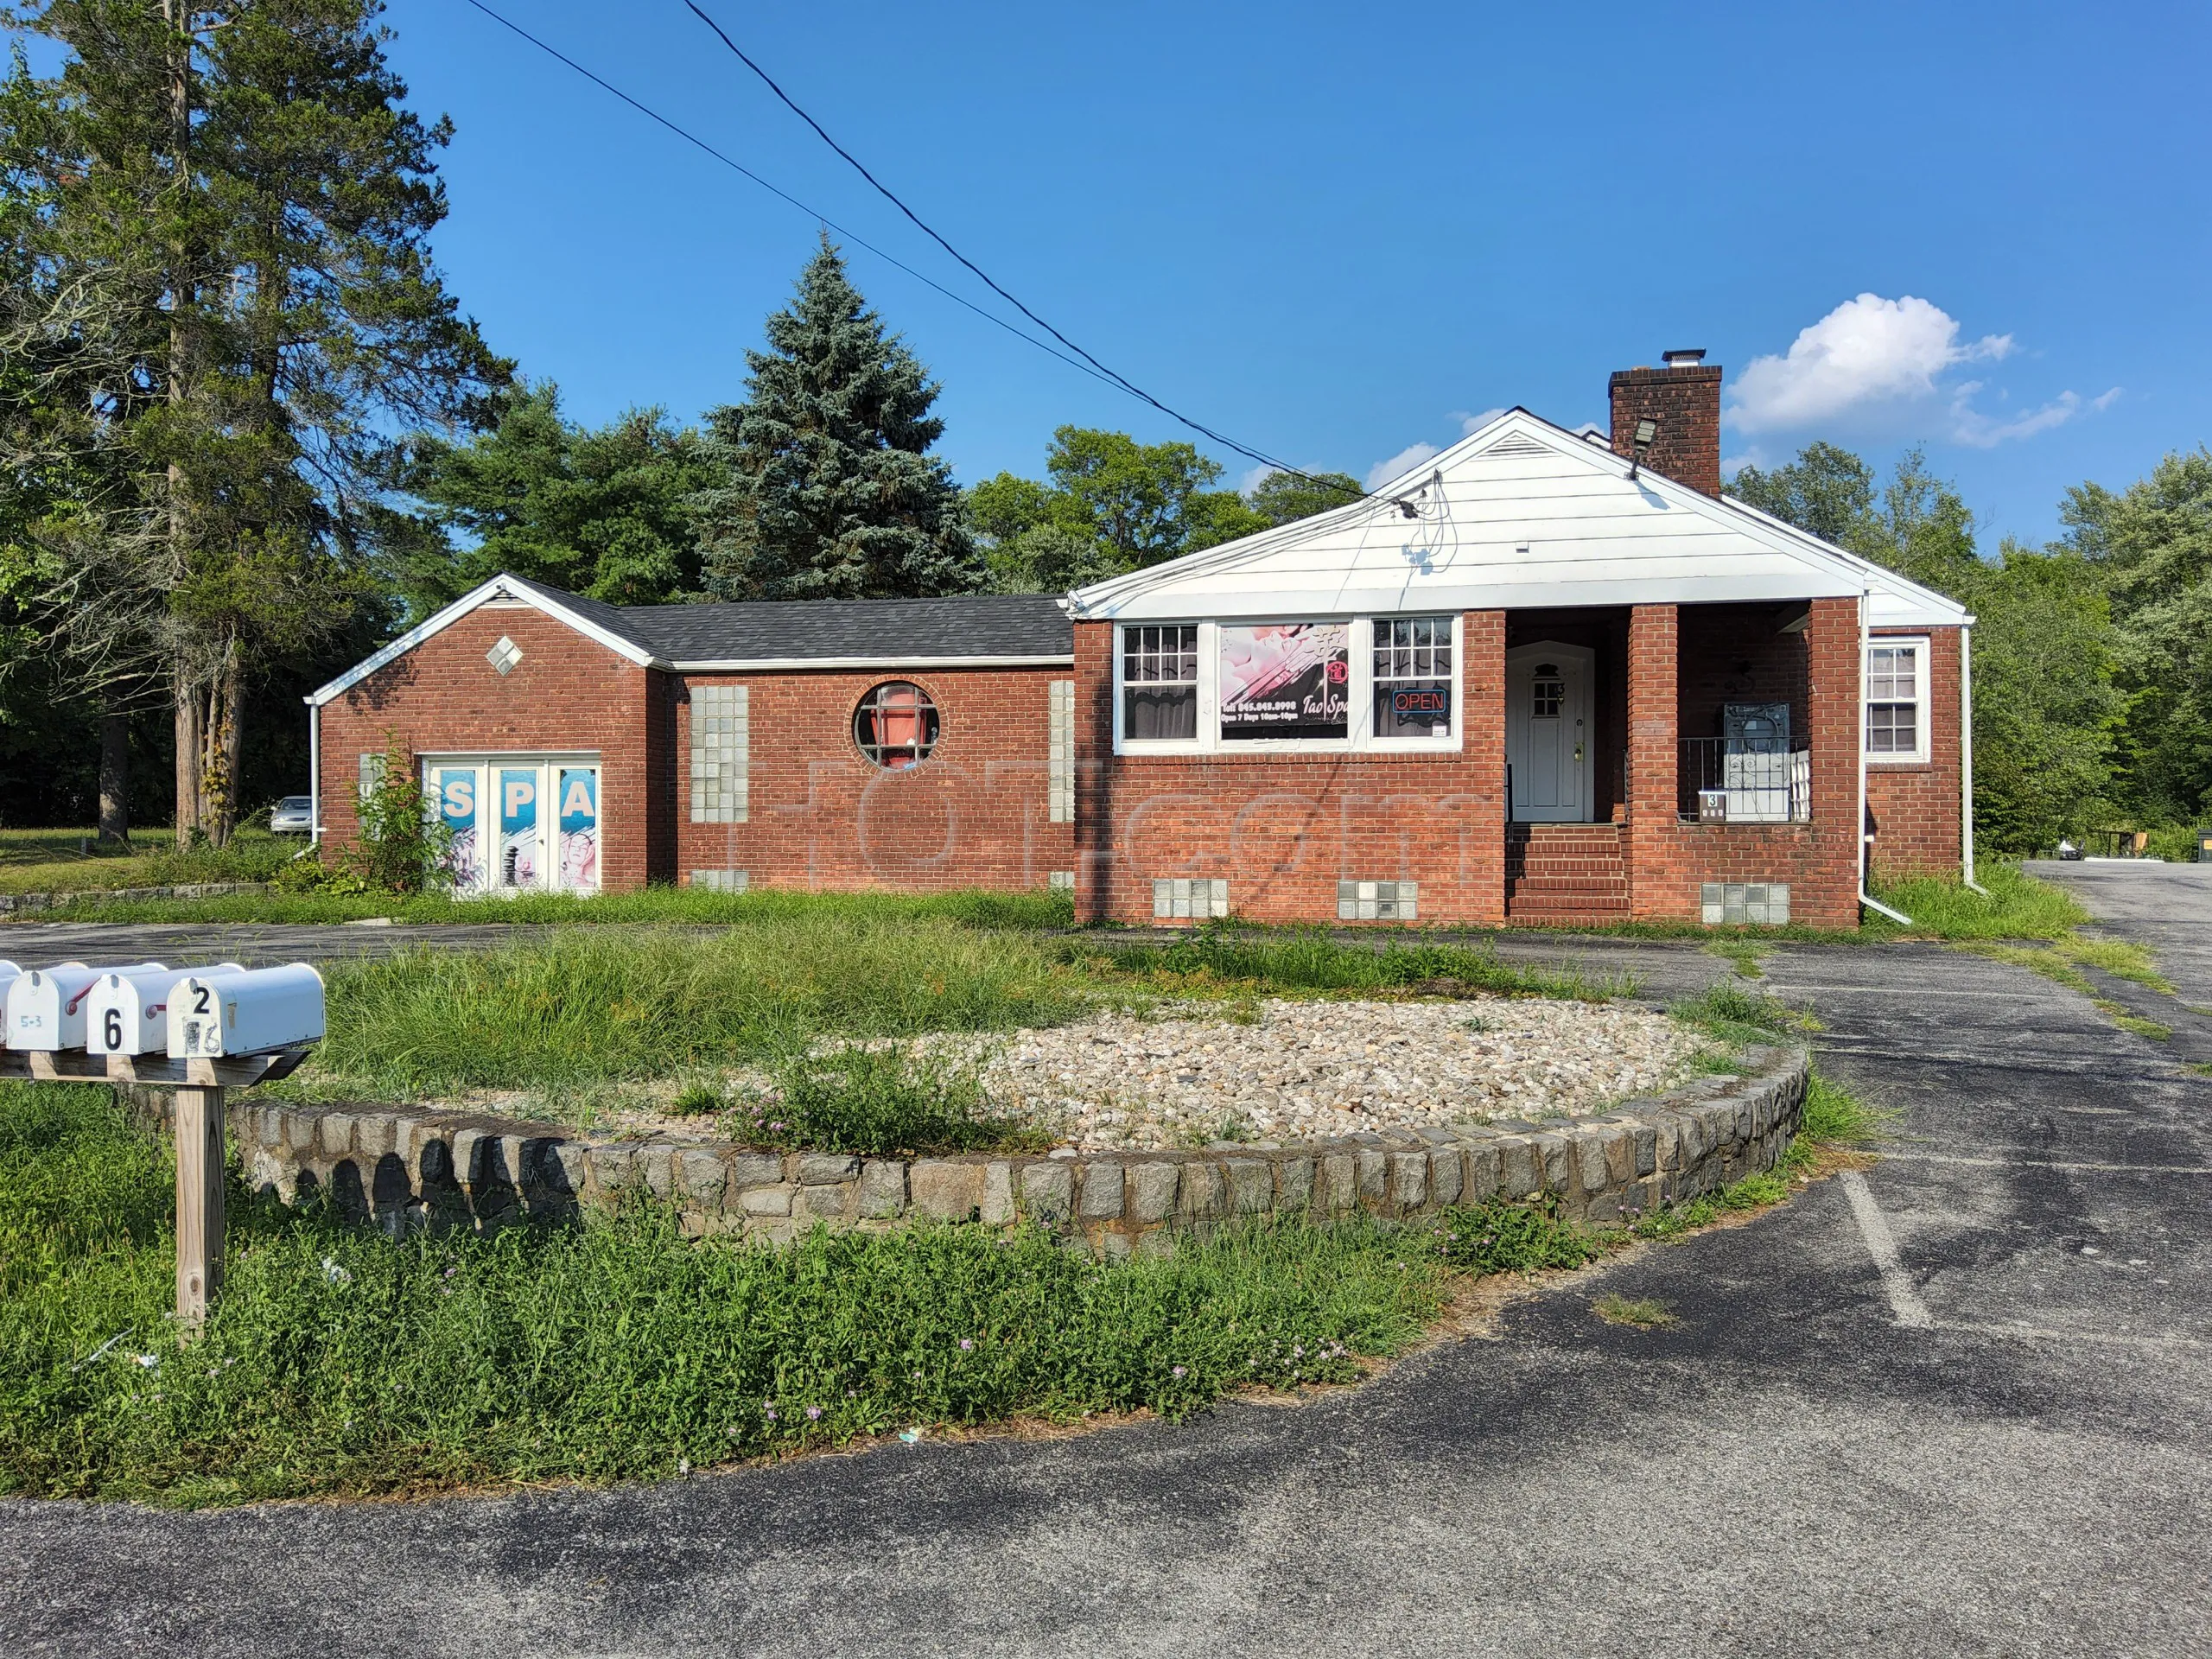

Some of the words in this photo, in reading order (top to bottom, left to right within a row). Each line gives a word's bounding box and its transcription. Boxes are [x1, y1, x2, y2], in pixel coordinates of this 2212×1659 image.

[1303, 695, 1324, 715] Tao
[1395, 693, 1444, 710] OPEN
[443, 781, 595, 817] SPA
[1709, 794, 1716, 806] 3
[193, 986, 210, 1014] 2
[104, 1007, 122, 1052] 6
